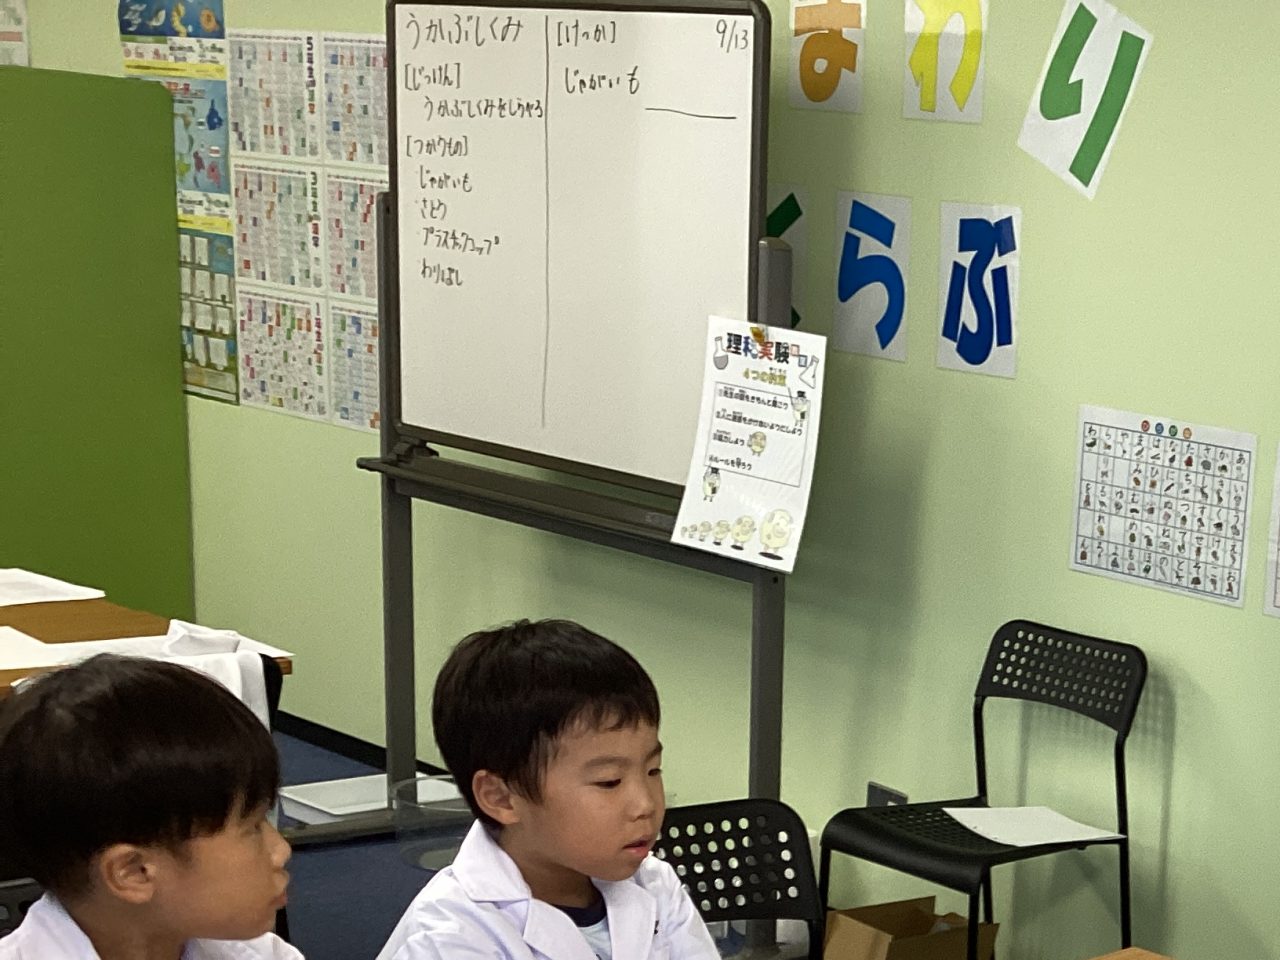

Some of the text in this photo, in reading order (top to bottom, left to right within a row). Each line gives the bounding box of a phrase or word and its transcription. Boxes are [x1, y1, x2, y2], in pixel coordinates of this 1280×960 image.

[406, 12, 523, 50] うかぶしくみ
[716, 19, 749, 53] 9/13
[565, 65, 640, 94] じゃがいも
